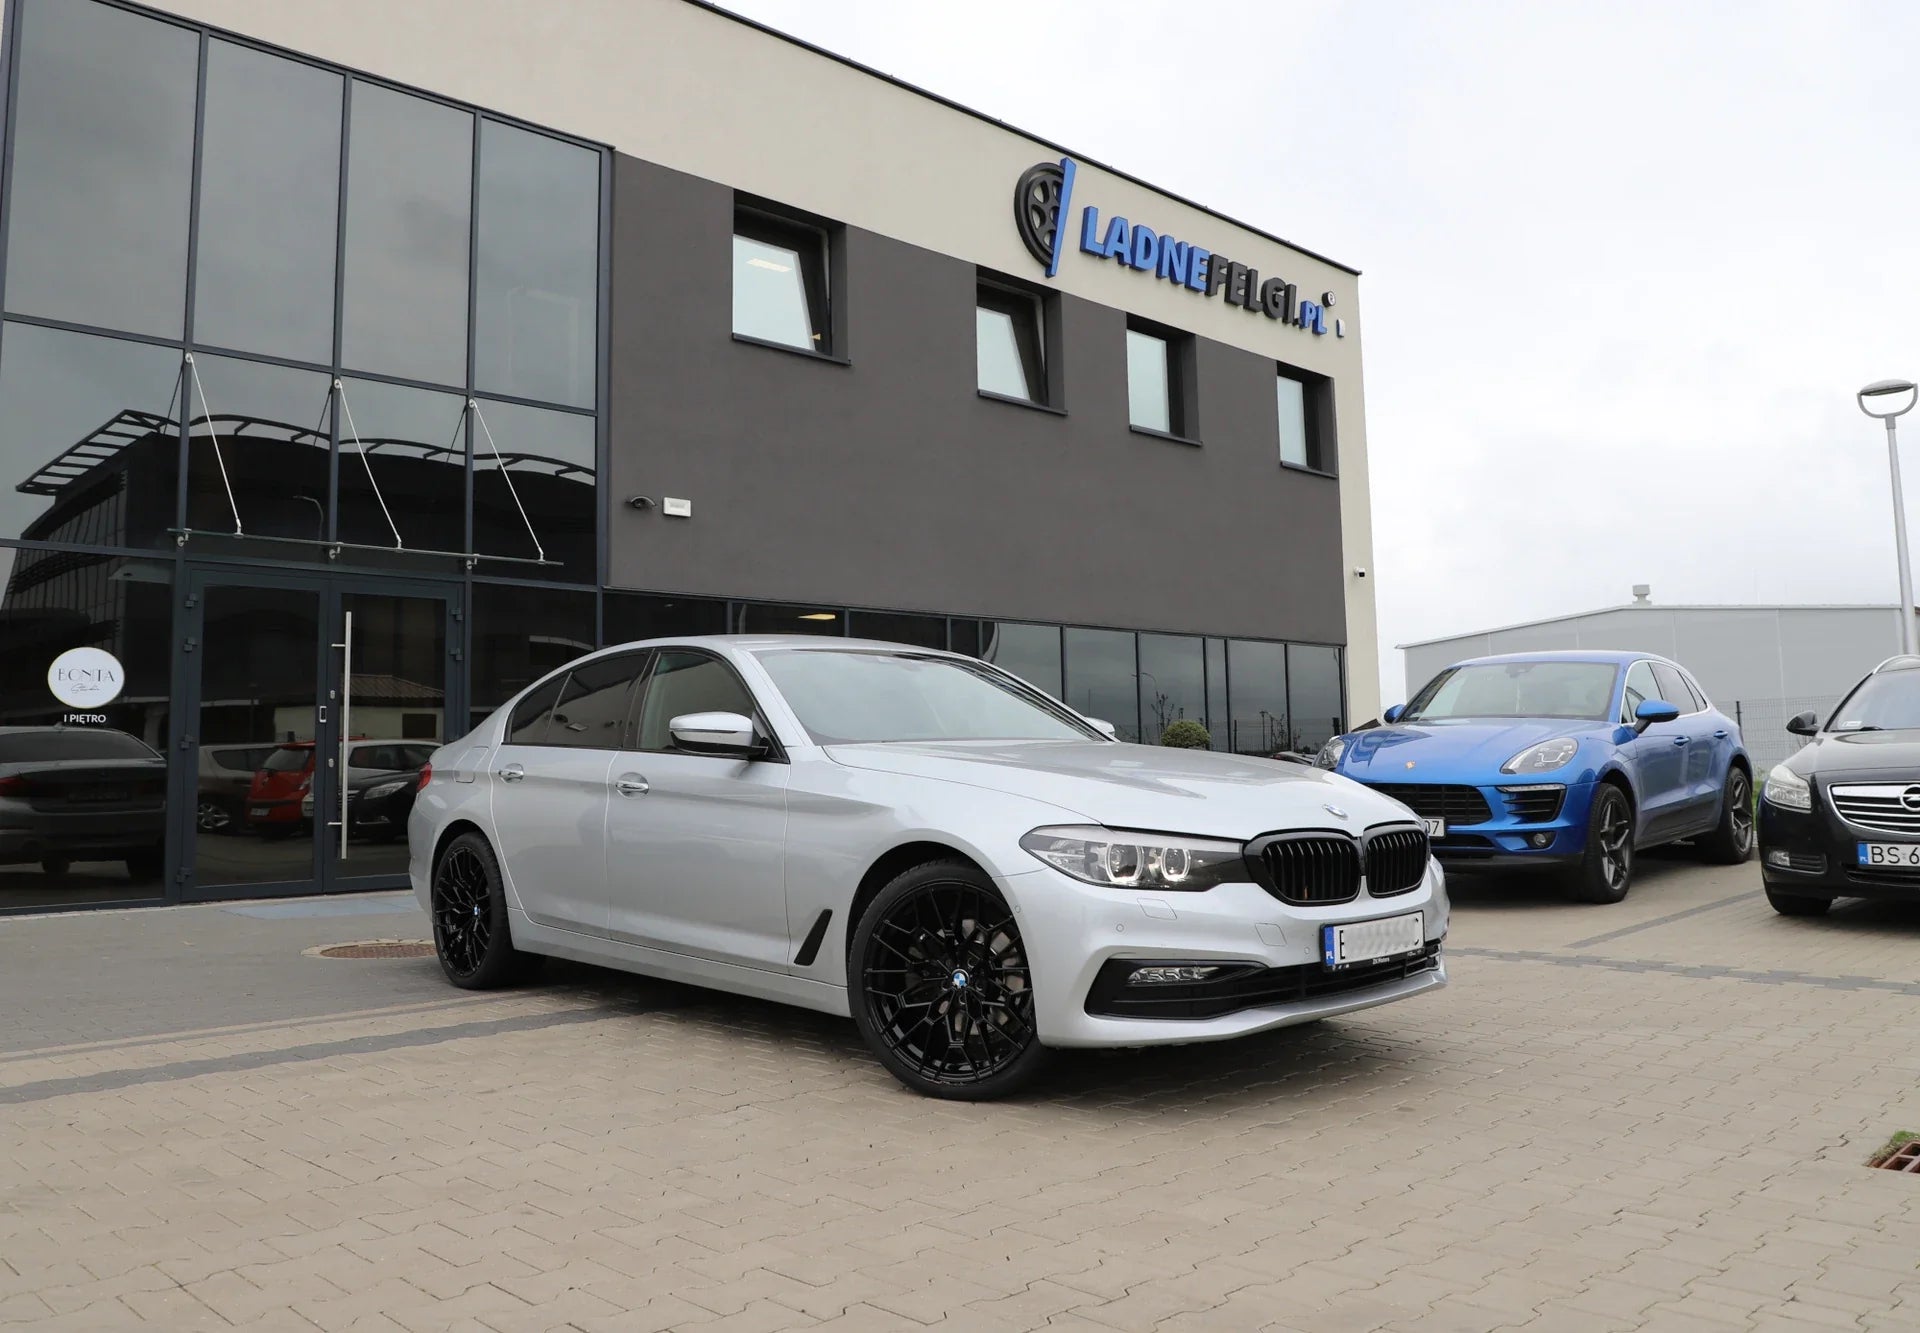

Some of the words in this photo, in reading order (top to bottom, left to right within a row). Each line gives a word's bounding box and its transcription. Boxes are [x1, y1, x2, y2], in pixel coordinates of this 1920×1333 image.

[1080, 205, 1328, 336] LADNEFELGI.PL
[69, 714, 107, 724] PIĘTRO
[1871, 845, 1901, 864] BS
